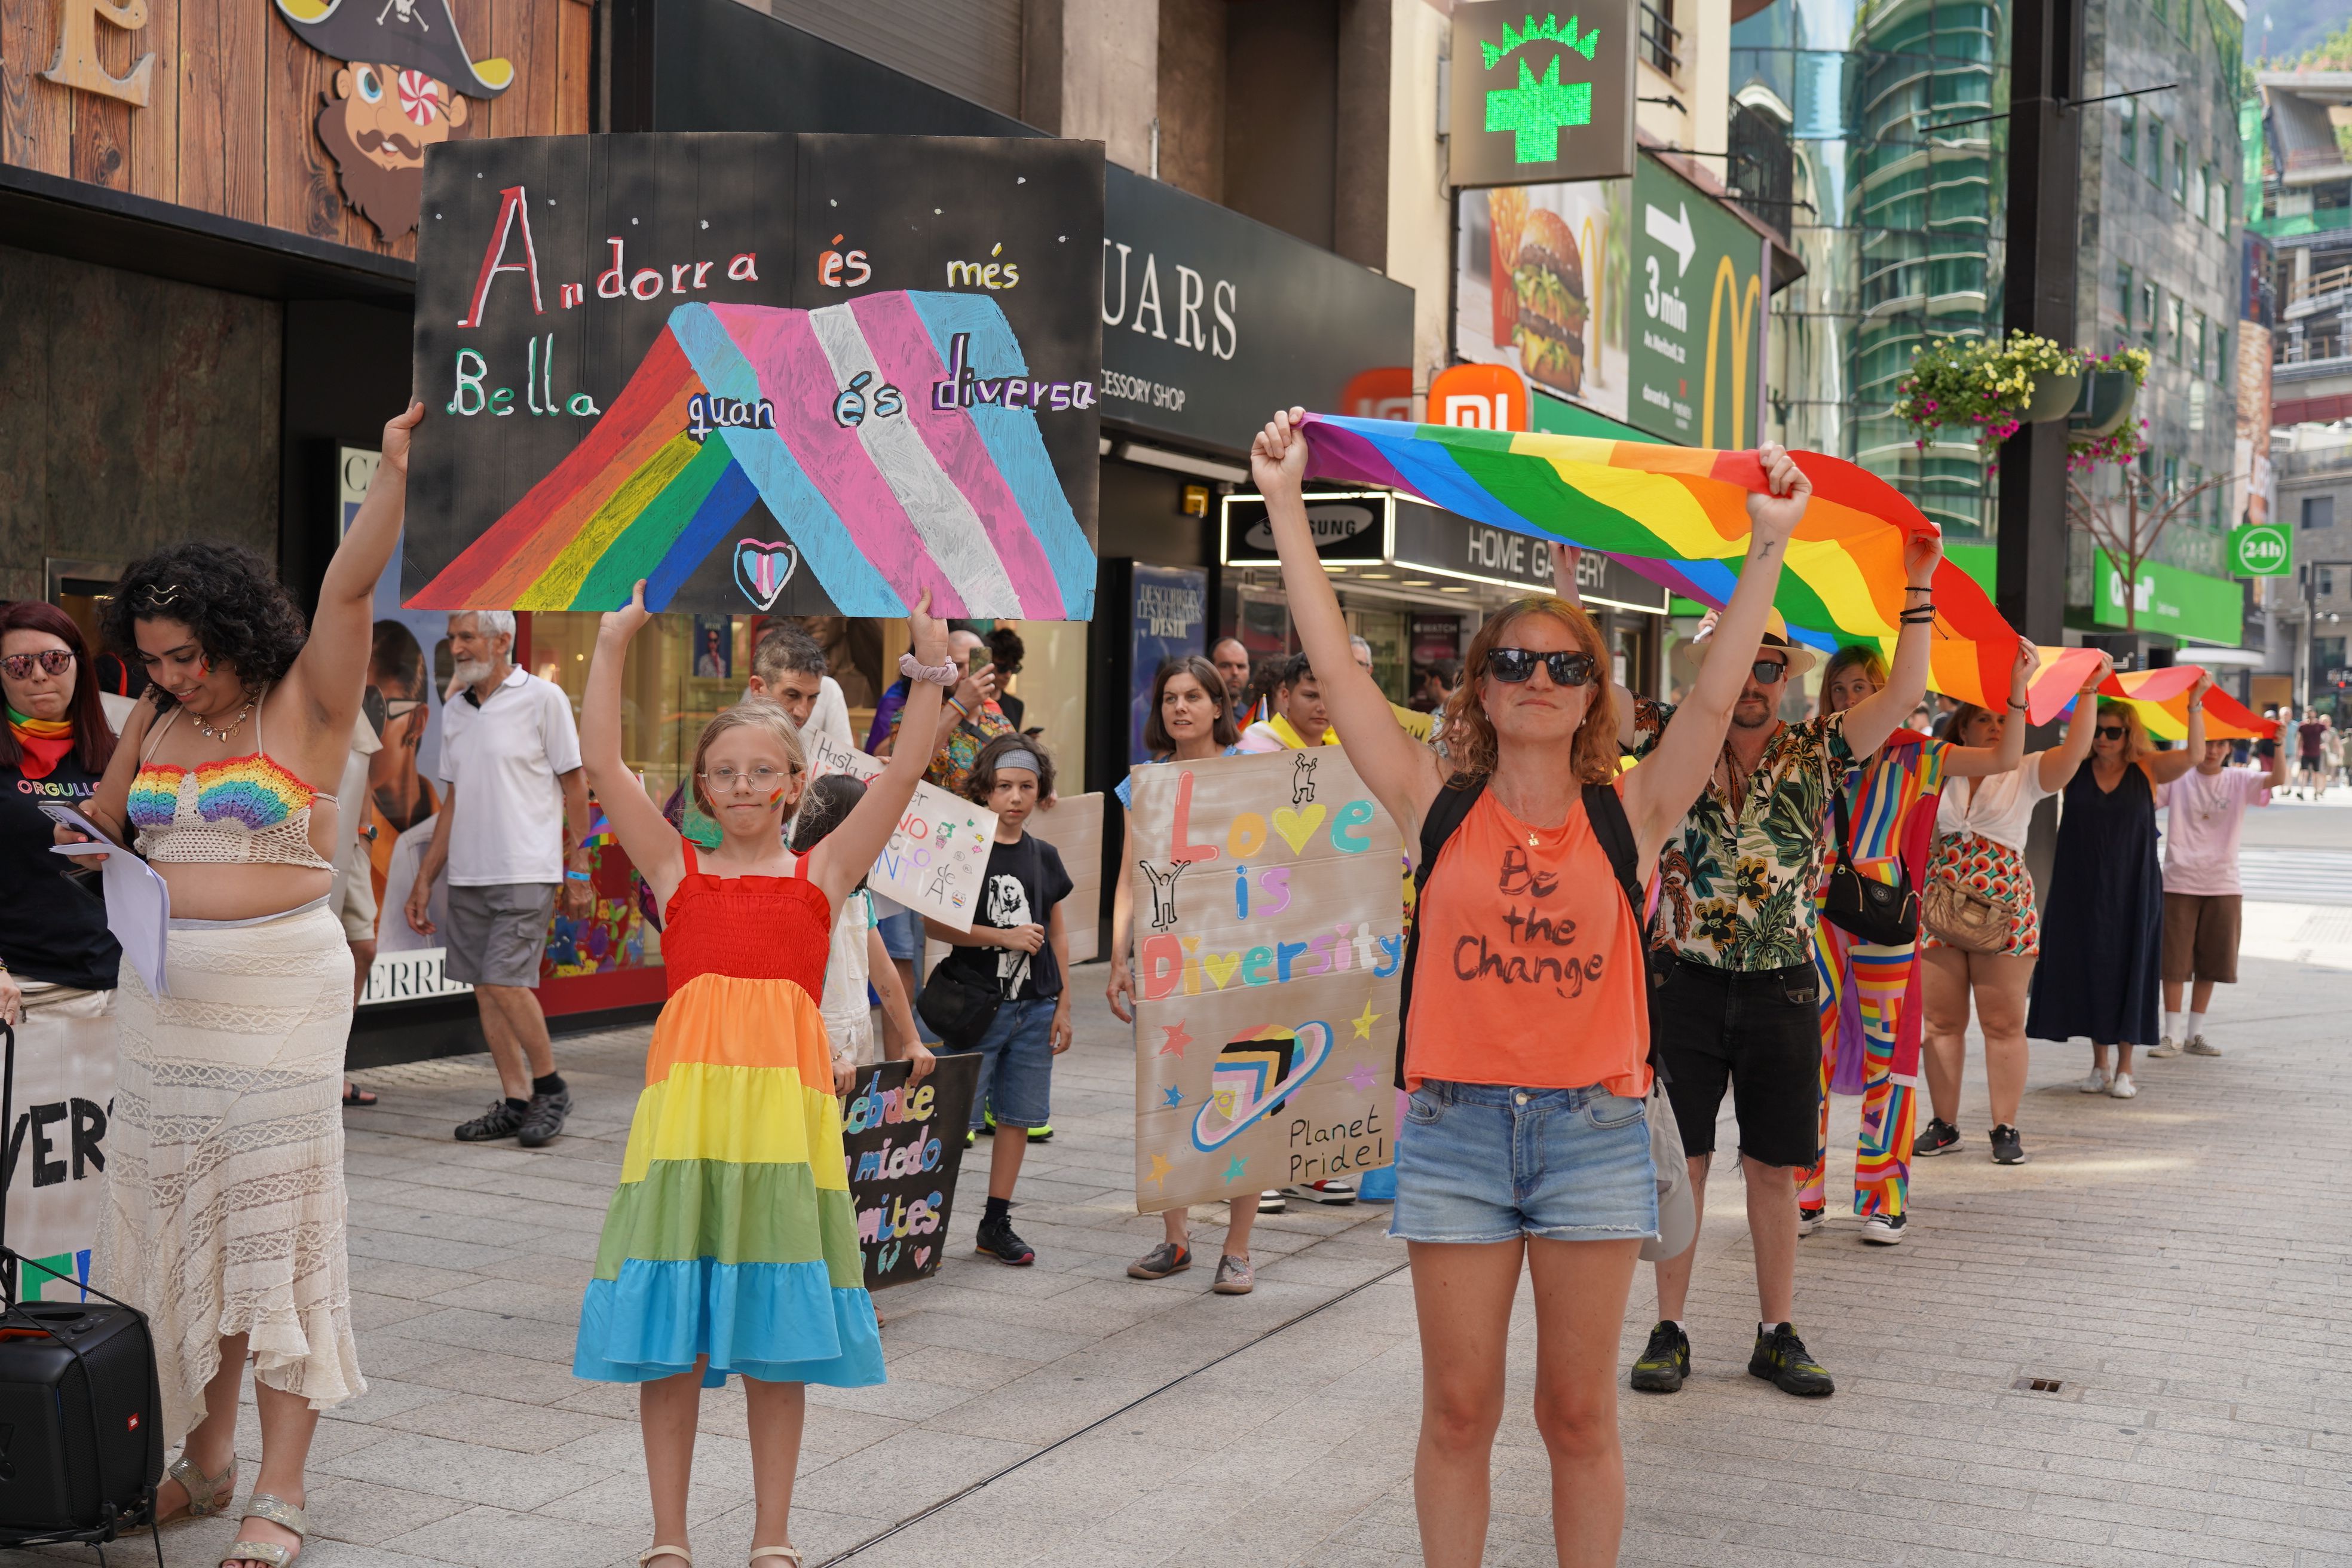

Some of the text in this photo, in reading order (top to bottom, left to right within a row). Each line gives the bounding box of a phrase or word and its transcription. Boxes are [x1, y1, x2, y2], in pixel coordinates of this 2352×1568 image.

[458, 186, 1019, 327] Andorra és més
[1644, 255, 1660, 318] 3
[1660, 285, 1688, 333] min
[446, 333, 1097, 441] Bella quan és diversa
[1153, 383, 1186, 412] SHOP
[1468, 525, 1524, 574] HOME
[2244, 541, 2281, 558] 24h
[817, 737, 859, 777] Hasta
[1235, 865, 1291, 920] is
[1499, 845, 1559, 898] Be
[1502, 905, 1577, 946] the
[1142, 922, 1402, 1001] Diversity
[1453, 935, 1604, 999] Change
[1290, 1104, 1382, 1149] Planet
